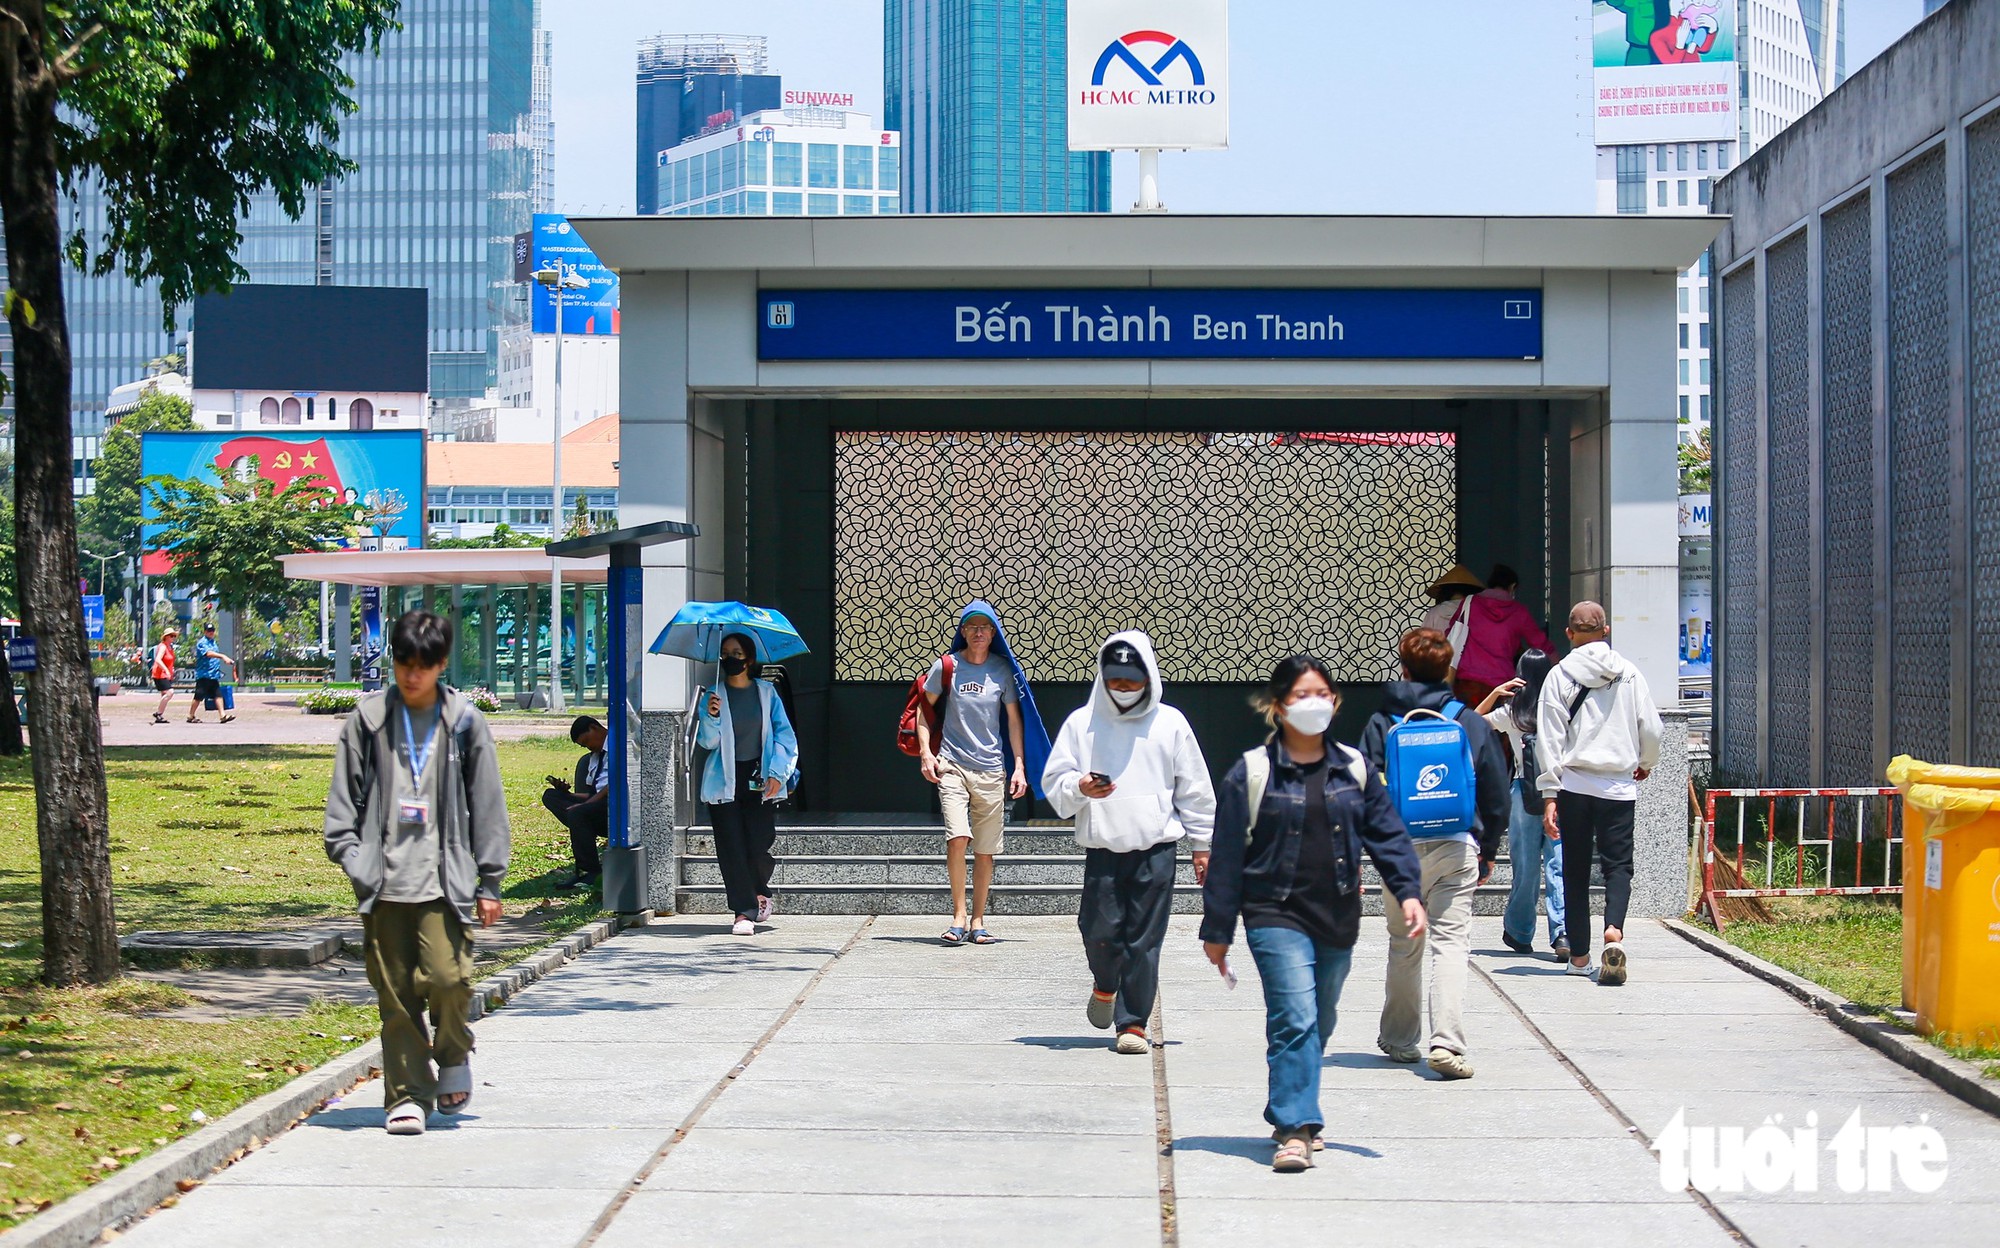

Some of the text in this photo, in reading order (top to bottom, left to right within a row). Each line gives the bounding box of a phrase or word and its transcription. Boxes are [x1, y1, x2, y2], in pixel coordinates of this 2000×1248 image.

[785, 90, 853, 106] SUNWAH
[1081, 90, 1216, 105] HCMC METRO
[753, 126, 775, 142] citi
[1515, 304, 1520, 315] 1
[775, 313, 787, 325] 01
[956, 302, 1344, 342] Bến Thành Ben Thanh
[960, 683, 985, 695] JUST
